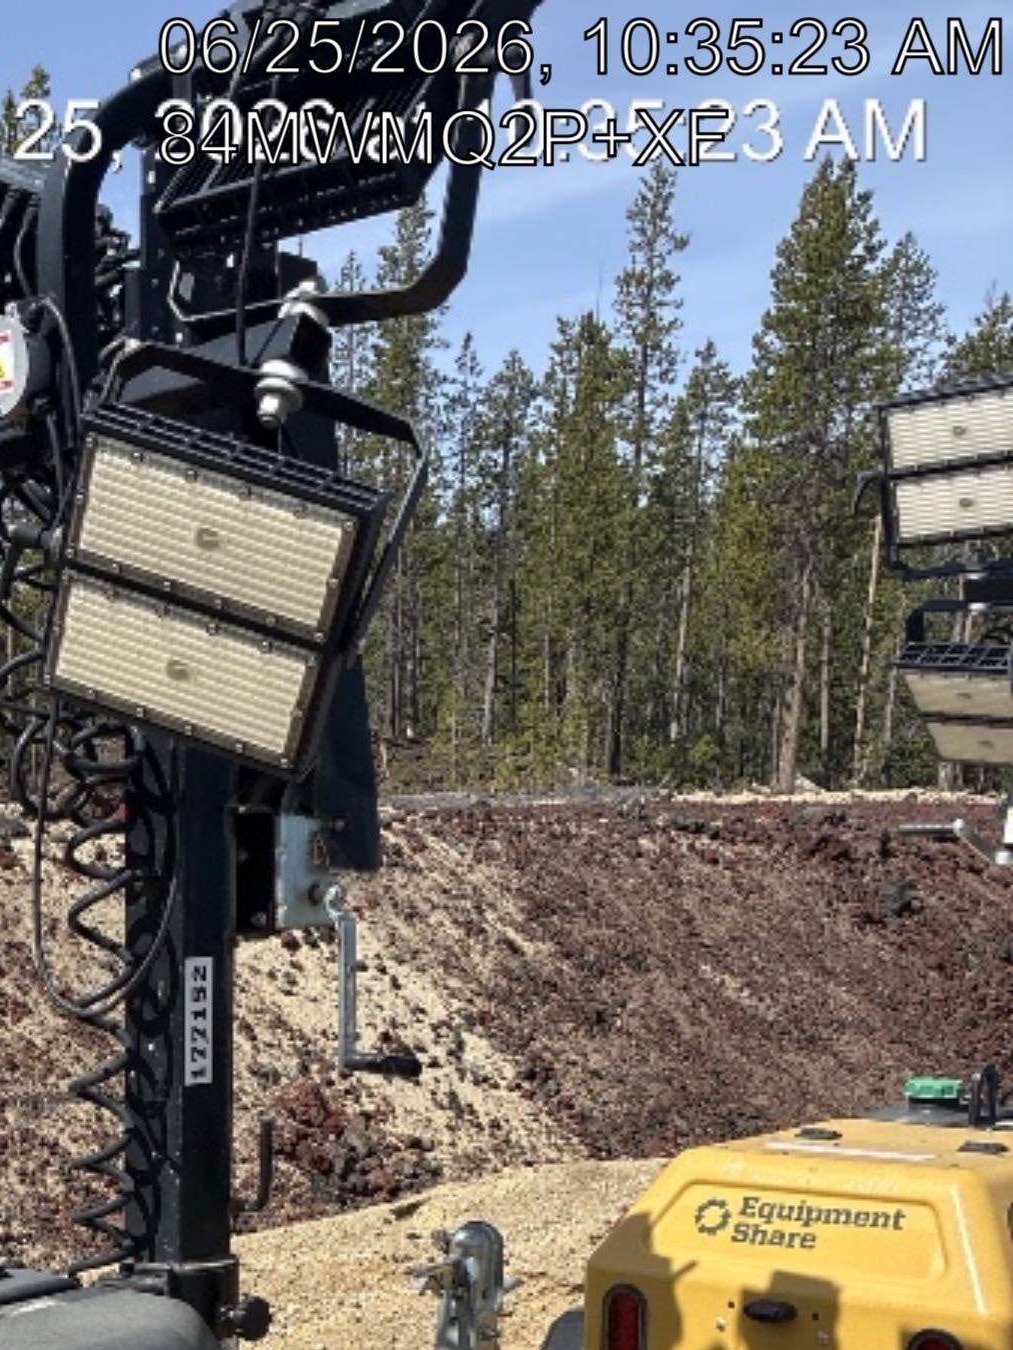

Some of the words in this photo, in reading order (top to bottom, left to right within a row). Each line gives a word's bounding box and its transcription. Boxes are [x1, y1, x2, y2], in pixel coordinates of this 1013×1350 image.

[190, 964, 209, 1079] 177152
[738, 1196, 907, 1231] Equipment
[731, 1223, 818, 1250] Share
